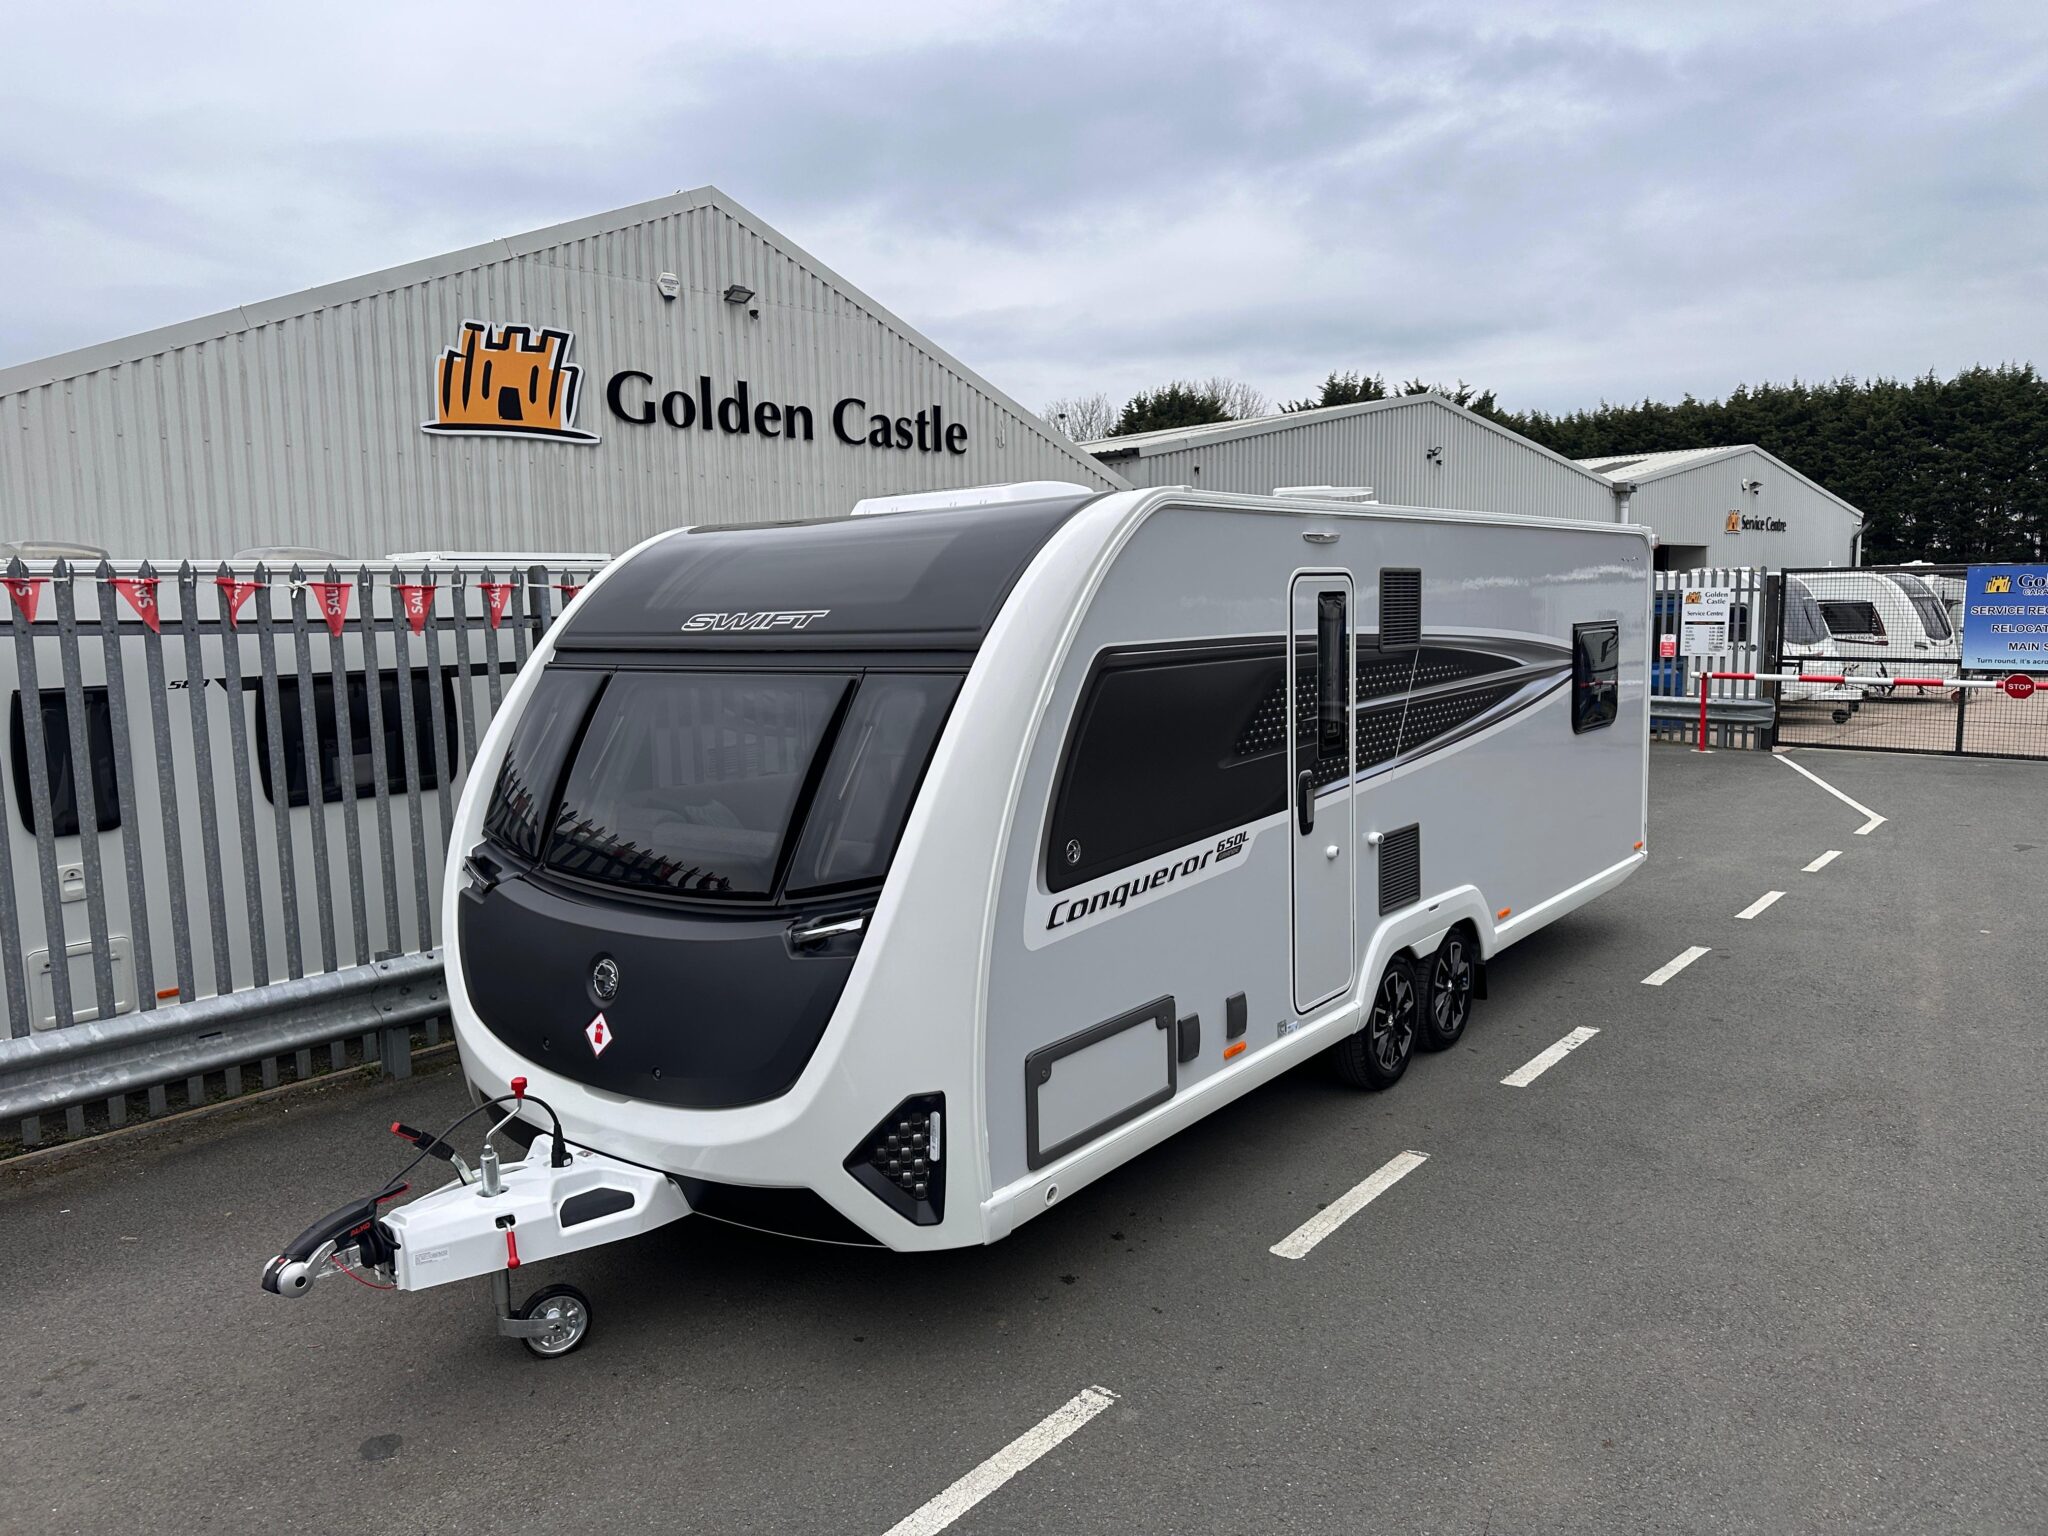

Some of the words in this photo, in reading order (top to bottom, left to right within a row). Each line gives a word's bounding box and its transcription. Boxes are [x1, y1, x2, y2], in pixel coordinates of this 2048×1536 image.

[606, 370, 814, 441] Golden
[832, 397, 968, 455] Castle
[1742, 514, 1765, 530] Service
[1766, 516, 1787, 532] Centre
[2018, 574, 2048, 588] Go
[1971, 606, 2025, 616] SERVICE
[681, 609, 831, 631] SWIFT
[2008, 641, 2040, 652] MAIN
[2007, 683, 2032, 691] STOP
[1046, 849, 1214, 930] Conqueror
[1217, 831, 1249, 852] 650L
